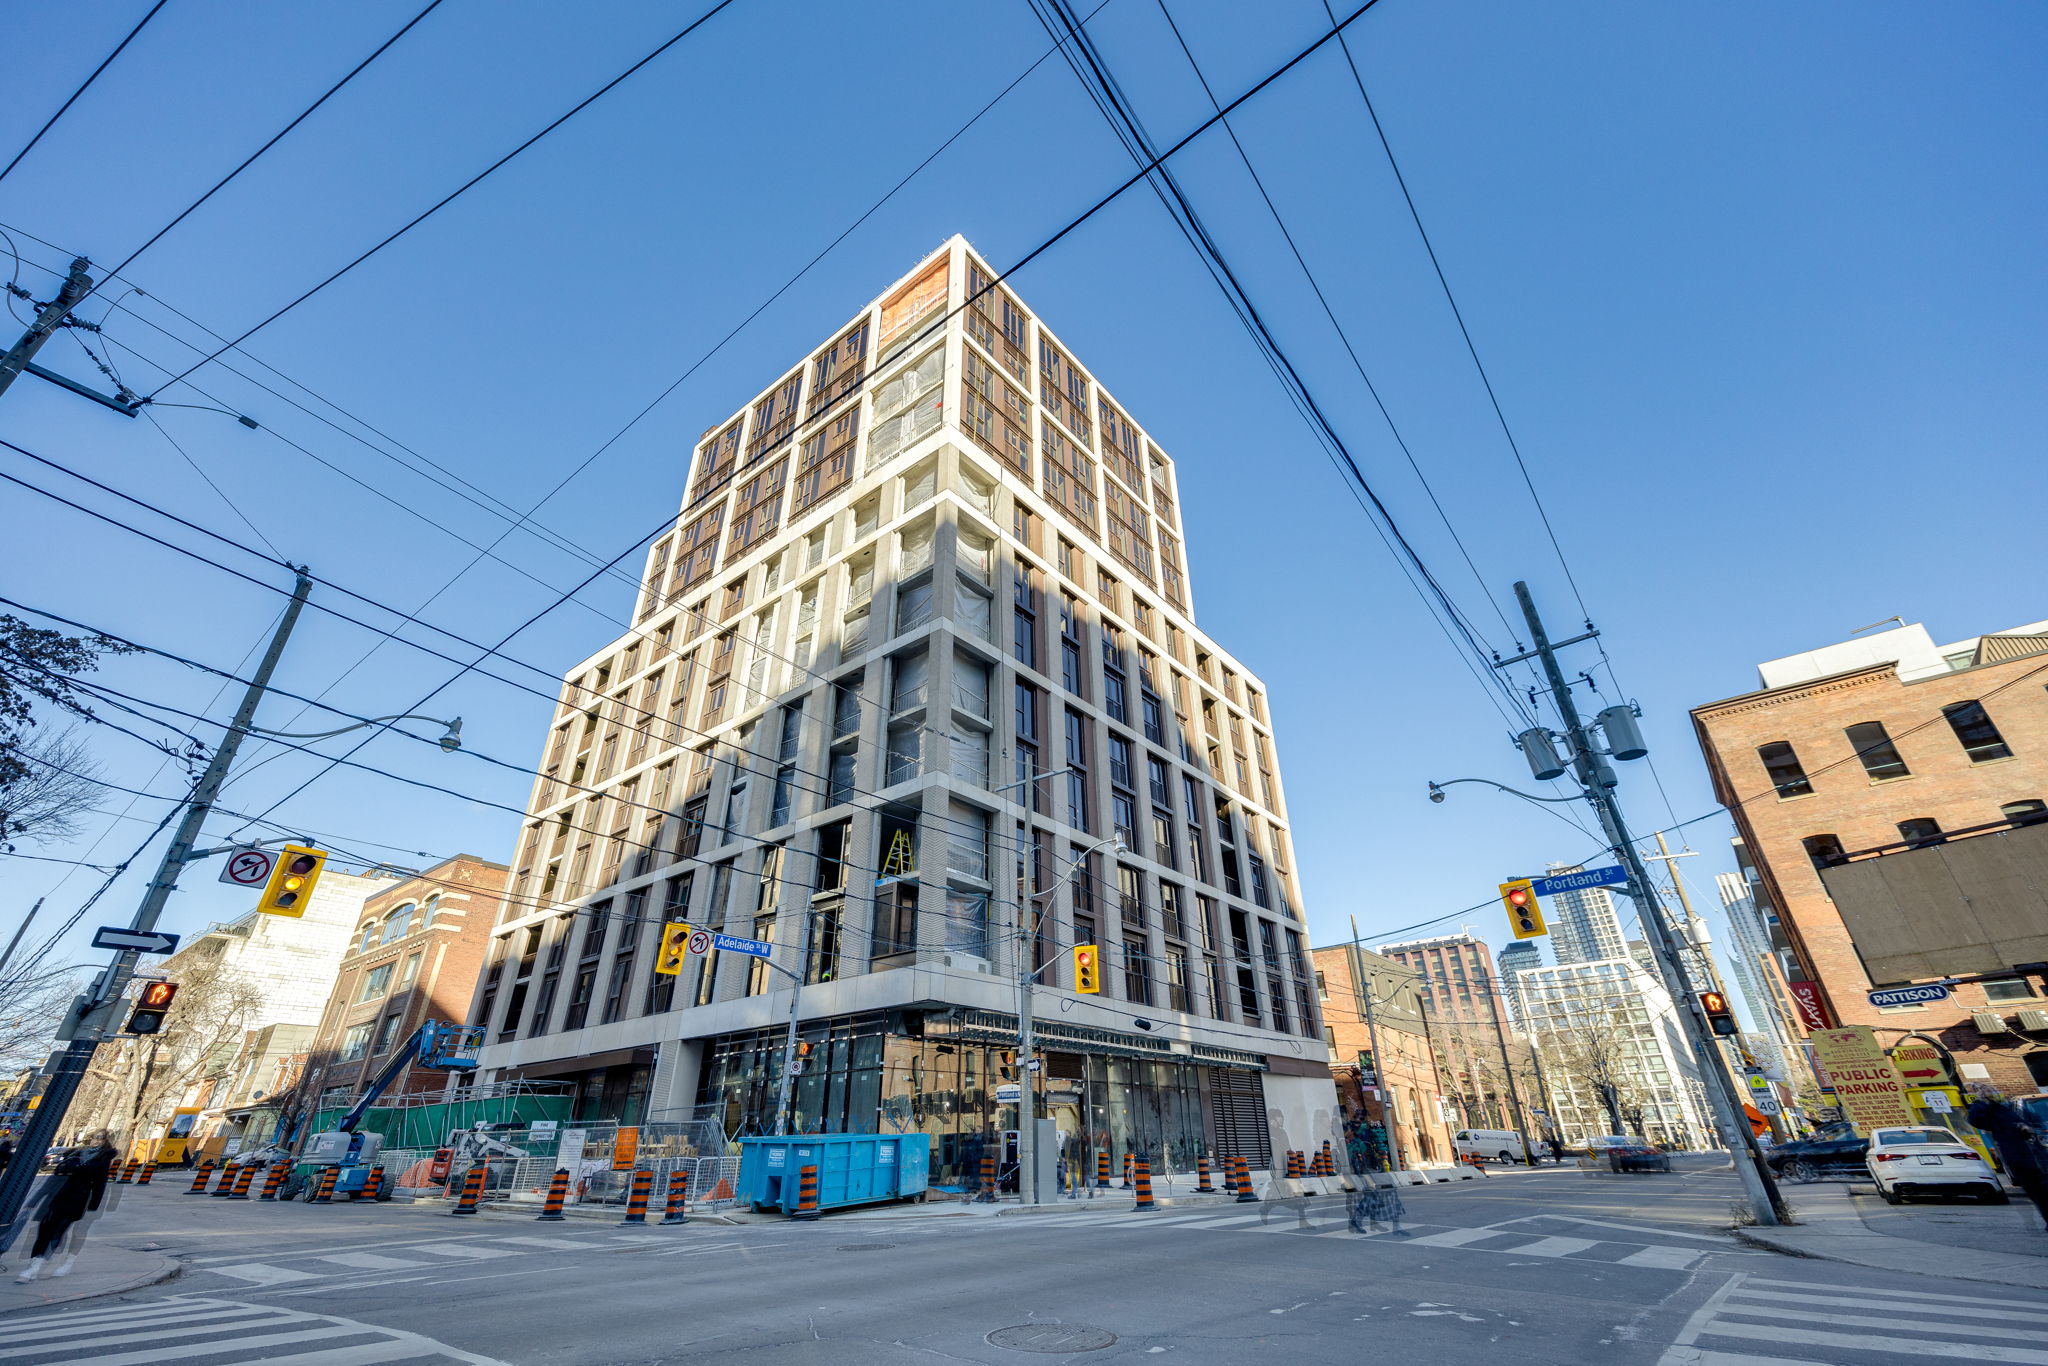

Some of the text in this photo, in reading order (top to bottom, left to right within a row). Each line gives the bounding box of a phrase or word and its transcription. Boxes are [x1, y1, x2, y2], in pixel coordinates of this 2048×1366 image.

[1544, 871, 1603, 891] Portland
[717, 937, 755, 952] Adelaide
[762, 944, 769, 954] W
[1873, 988, 1944, 1005] PATTISON
[1893, 1047, 1937, 1062] ARKING
[1829, 1068, 1891, 1082] PUBLIC
[1836, 1081, 1899, 1095] PARKING
[1760, 1101, 1776, 1111] 40
